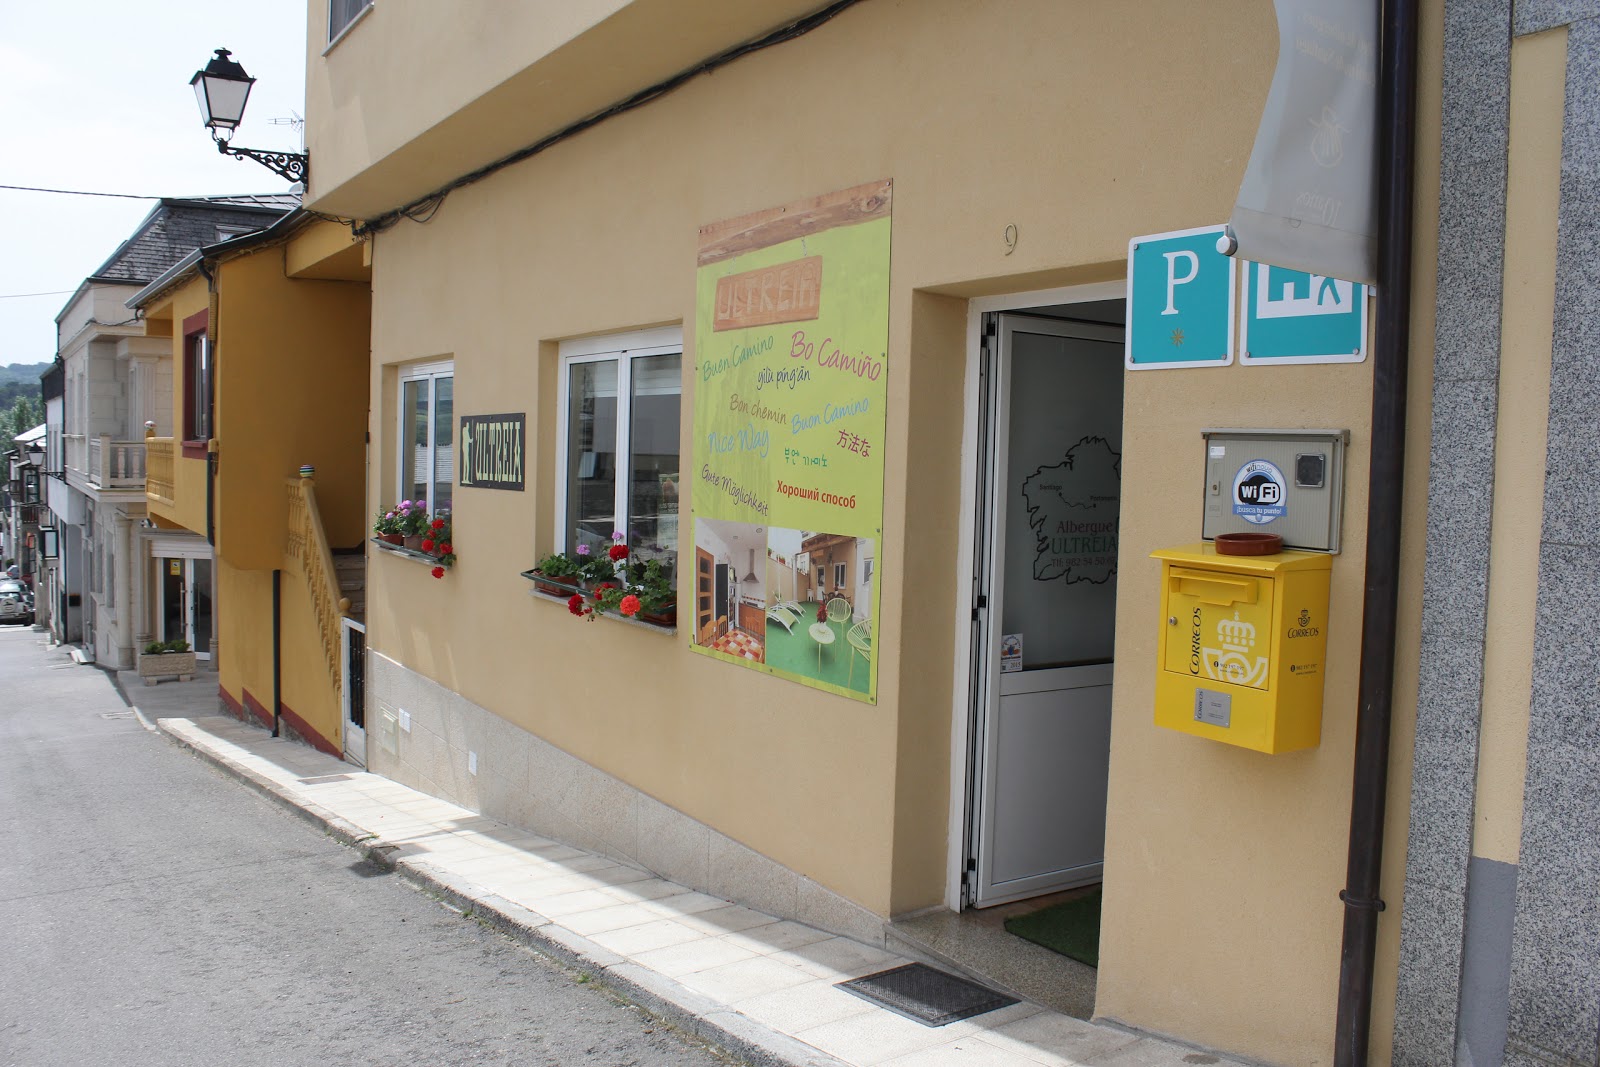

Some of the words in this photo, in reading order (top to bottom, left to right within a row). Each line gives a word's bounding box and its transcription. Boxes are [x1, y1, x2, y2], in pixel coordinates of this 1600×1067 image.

[1005, 223, 1018, 256] 9
[717, 262, 817, 320] ULTREIA
[1160, 250, 1199, 316] P
[703, 357, 730, 381] Buen
[732, 335, 774, 367] Camino
[790, 330, 814, 360] Bo
[817, 337, 882, 381] Camiño
[729, 393, 749, 413] Bon
[791, 414, 821, 435] Buon
[823, 398, 869, 425] Camino
[475, 421, 522, 483] ULTREIA
[738, 423, 770, 458] Way
[836, 429, 871, 458] 方法な
[702, 463, 720, 486] Gute
[722, 476, 768, 516] Möglichkeit
[777, 480, 819, 501] Хороший
[821, 491, 856, 509] способ
[1051, 536, 1117, 555] ULTREIA
[1056, 520, 1113, 536] Albergue
[1065, 557, 1081, 567] 982
[1189, 606, 1202, 675] CORREOS
[1288, 627, 1319, 639] CORREOS
